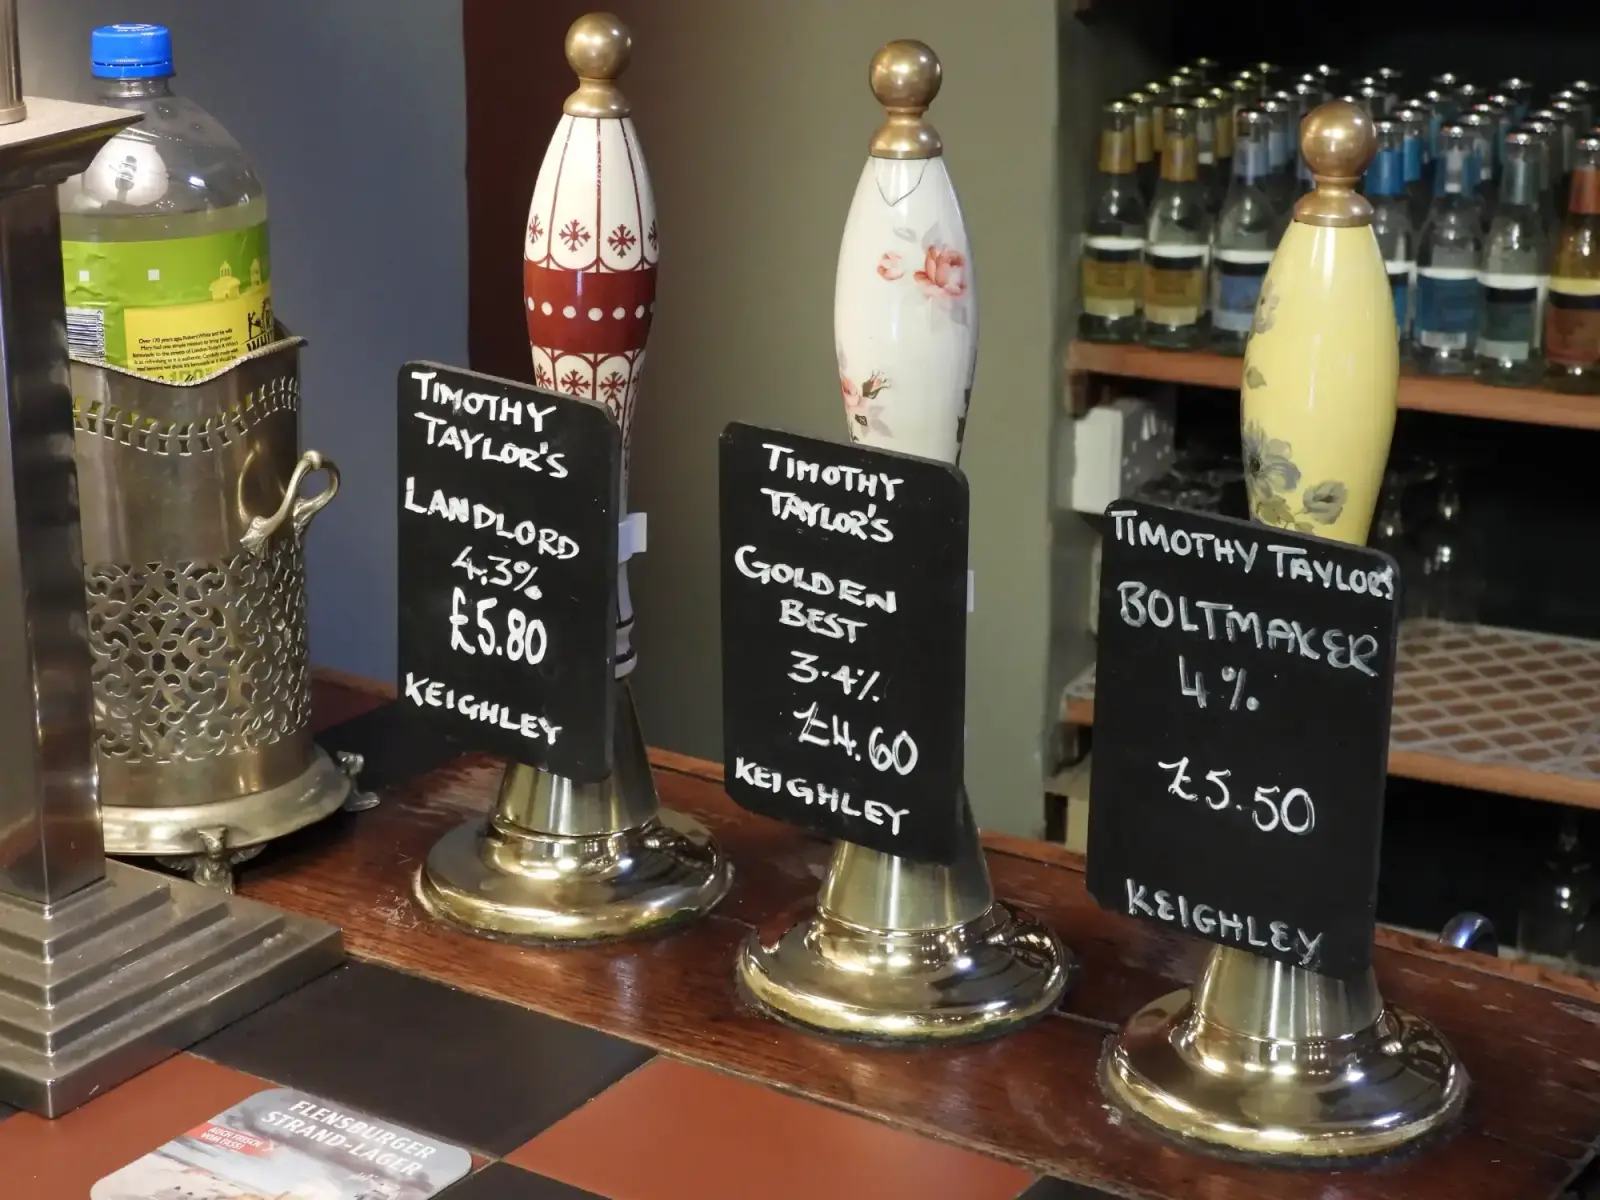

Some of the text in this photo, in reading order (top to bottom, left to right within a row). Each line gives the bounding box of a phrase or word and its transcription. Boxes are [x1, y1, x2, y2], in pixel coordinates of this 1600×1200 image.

[411, 371, 557, 433] TIMOTHY
[414, 411, 569, 479] TAYLOR'S
[761, 443, 905, 502] TIMOTHY
[404, 476, 580, 560] LANDLORD
[760, 487, 895, 543] TAYLOR'S
[1111, 509, 1259, 574] TIMOTHY
[451, 546, 543, 600] 4.3%
[734, 544, 898, 614] GOLDEN
[449, 586, 548, 665] £5.80
[778, 598, 869, 644] BEST
[1116, 580, 1379, 677] BOLTMAKER
[404, 671, 563, 746] KEIGHLEY
[793, 701, 919, 776] £4.60
[734, 756, 910, 836] KEIGHLEY
[1156, 756, 1316, 836] £5.50
[1125, 877, 1325, 967] KEIGHLEY
[260, 1110, 424, 1177] STRAND-LAGER
[288, 1100, 437, 1160] FLENSBURGER
